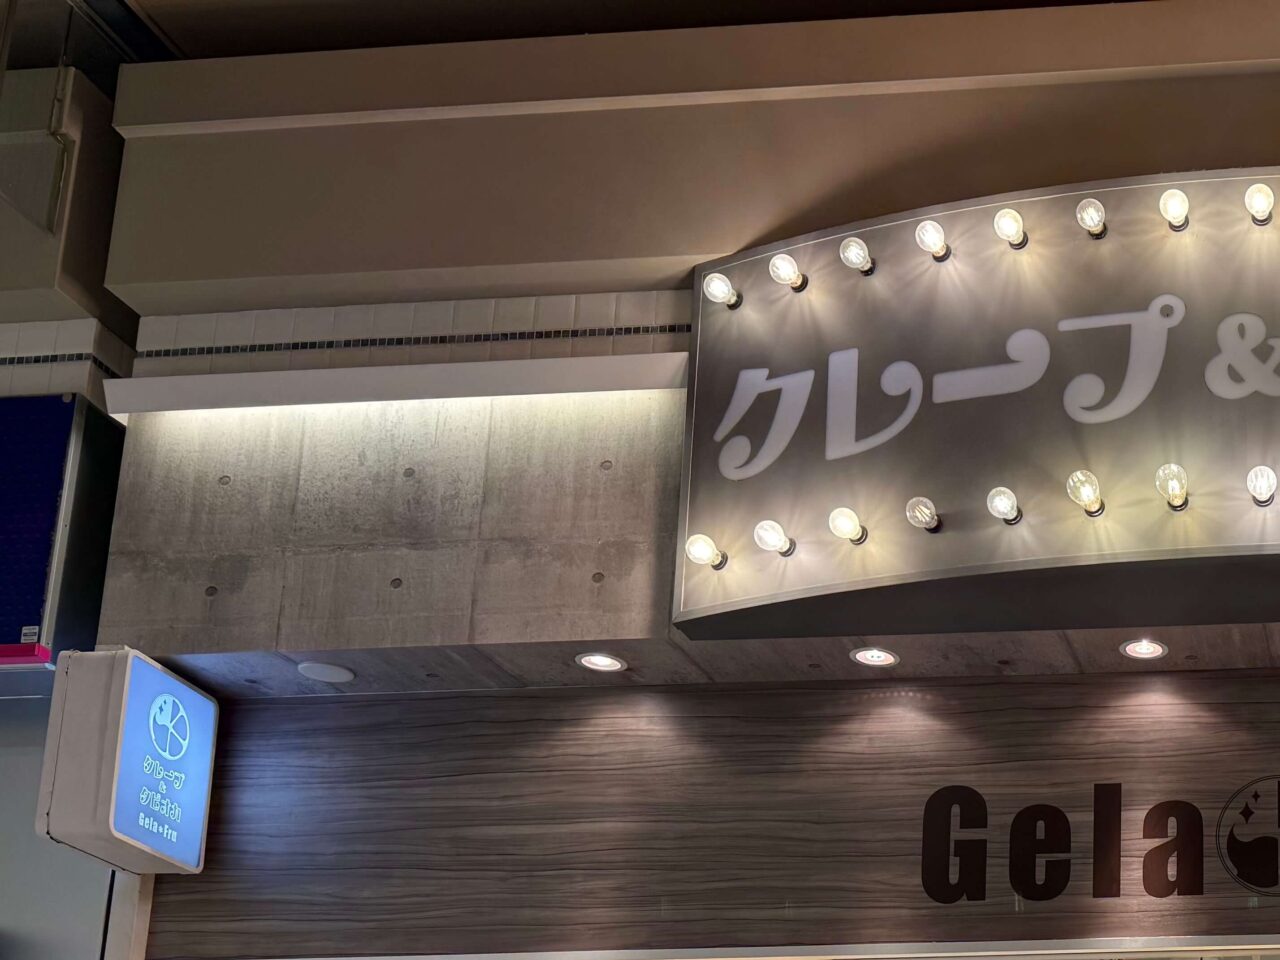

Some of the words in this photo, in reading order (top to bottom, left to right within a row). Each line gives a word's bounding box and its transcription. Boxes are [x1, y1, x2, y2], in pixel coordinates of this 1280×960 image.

[714, 293, 1185, 481] クレープ
[140, 787, 181, 822] タピオカ
[144, 755, 185, 789] クレープ
[921, 783, 1203, 904] Gela
